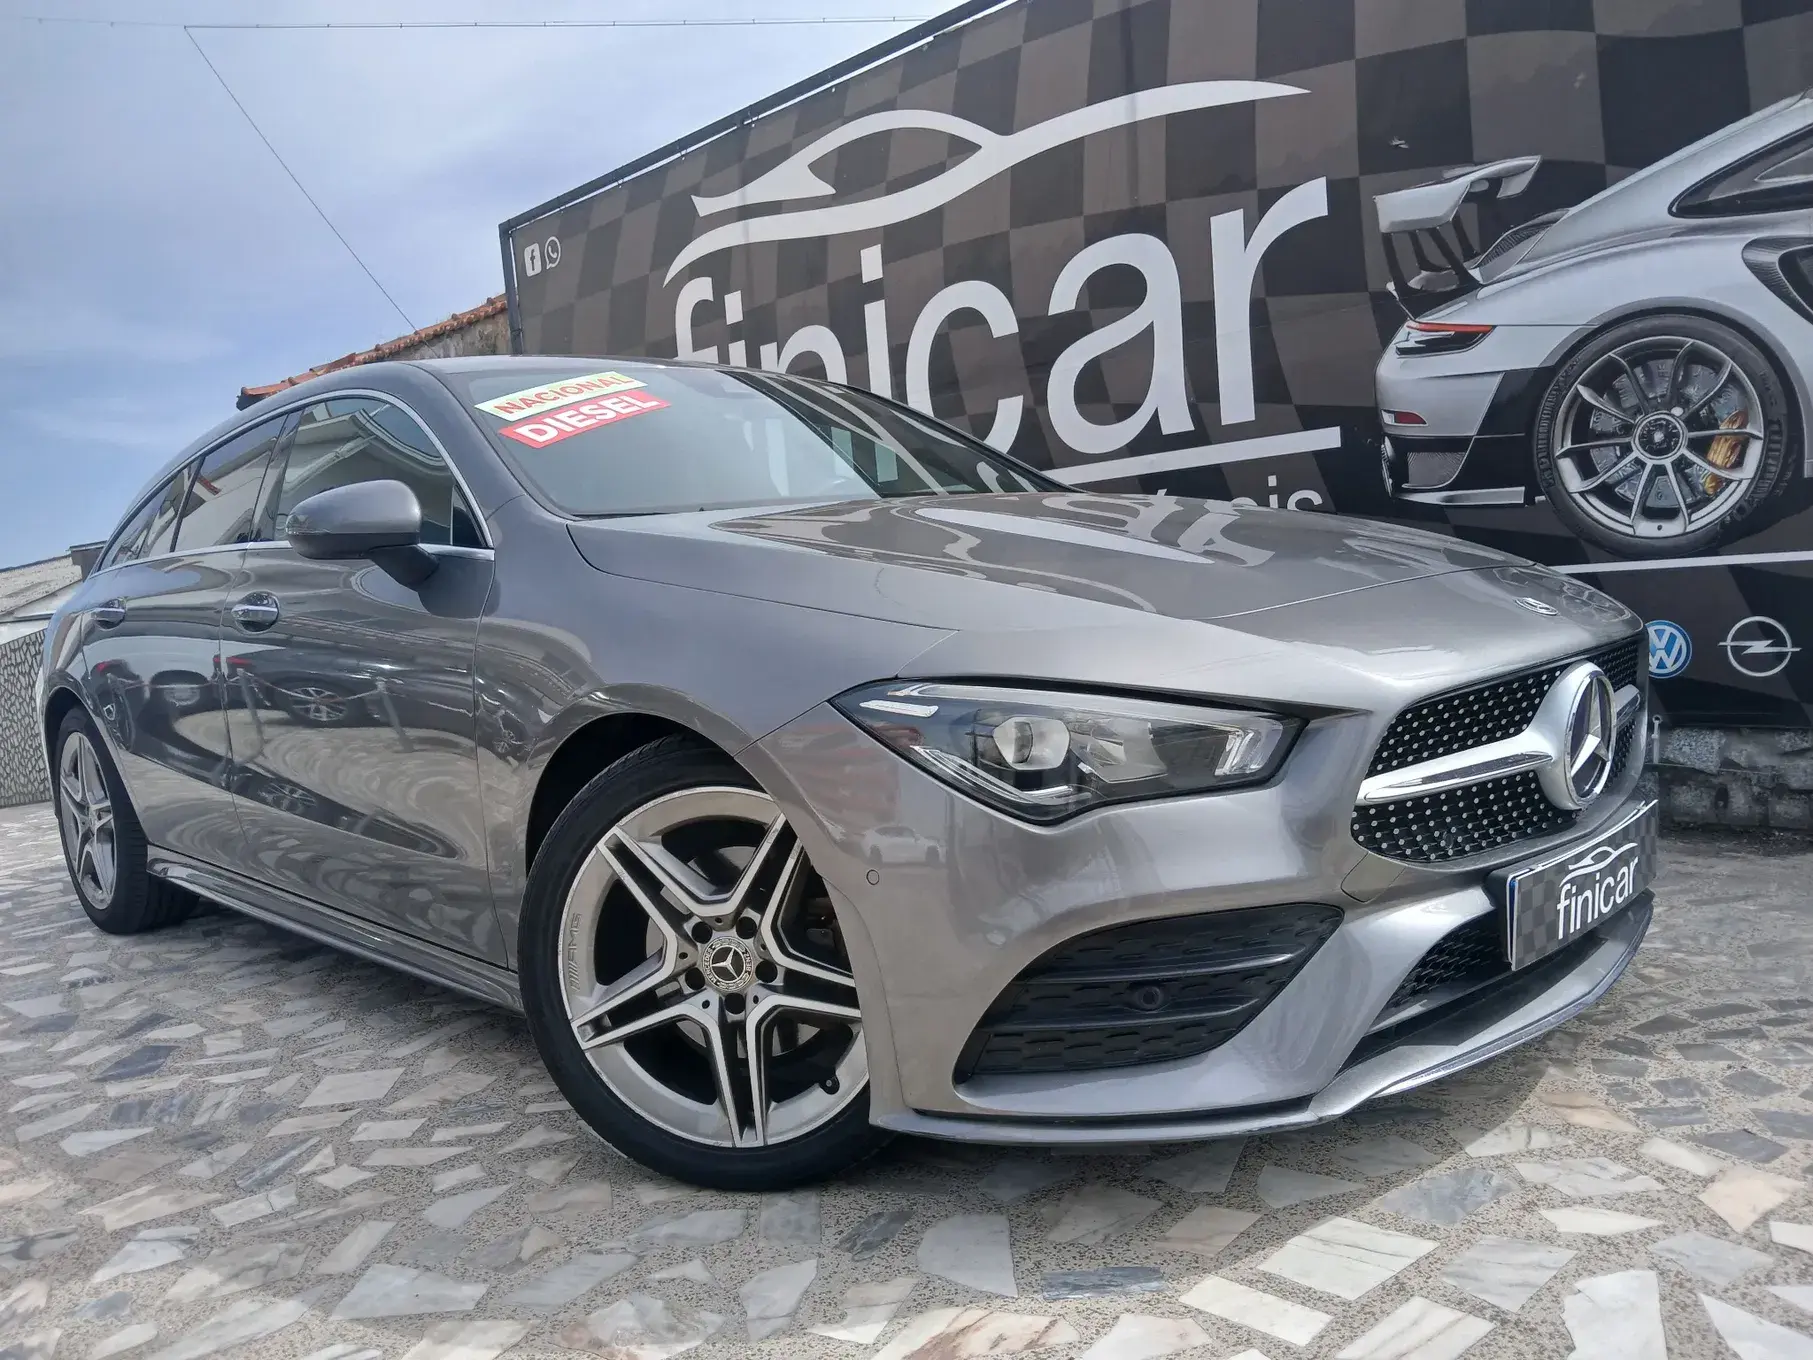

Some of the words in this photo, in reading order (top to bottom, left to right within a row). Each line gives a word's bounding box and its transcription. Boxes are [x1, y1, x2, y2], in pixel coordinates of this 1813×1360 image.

[493, 375, 636, 415] NACIONAL
[513, 395, 661, 443] DIESEL
[1556, 856, 1639, 940] finicar
